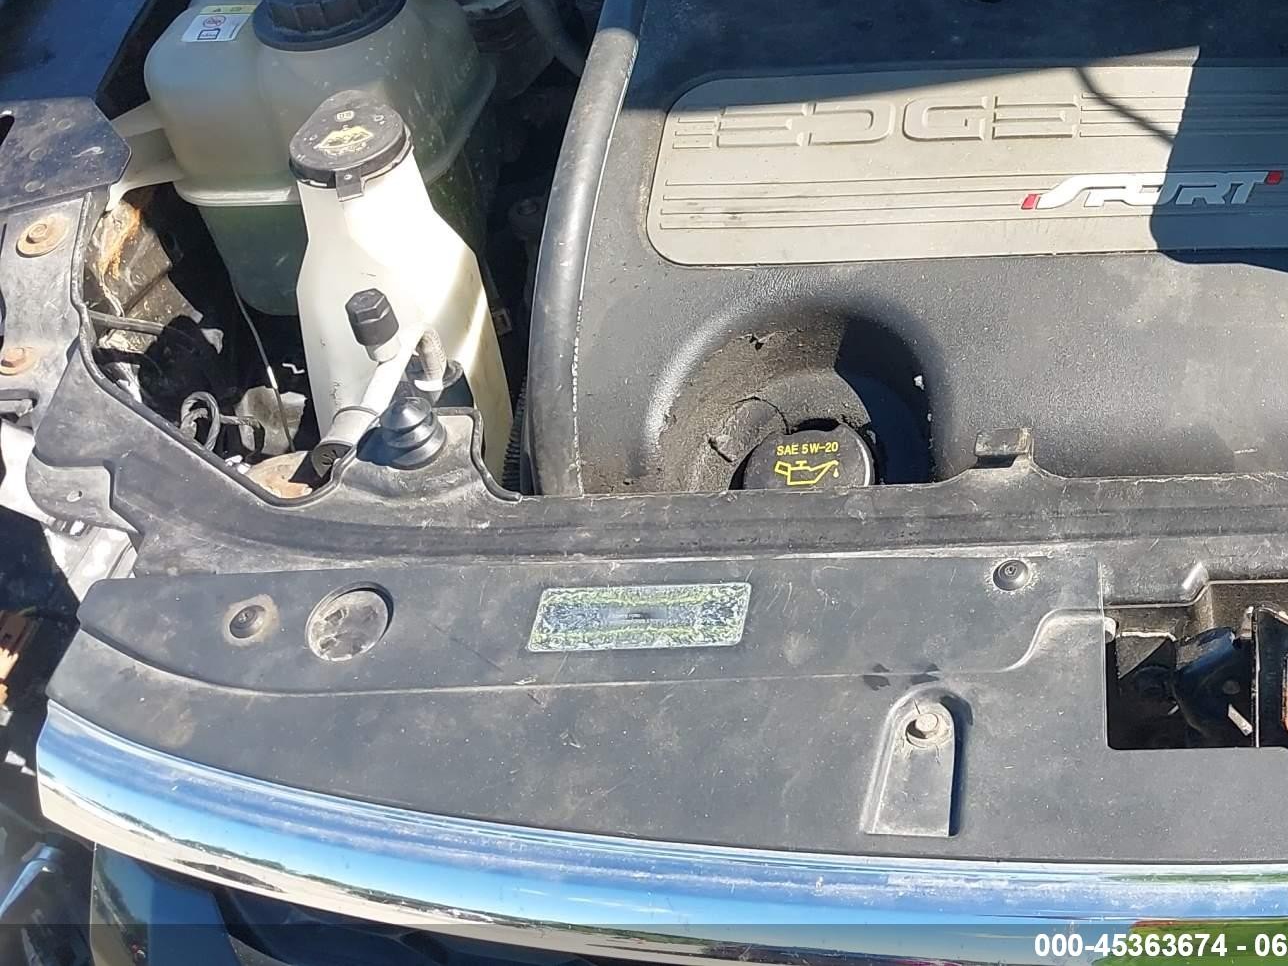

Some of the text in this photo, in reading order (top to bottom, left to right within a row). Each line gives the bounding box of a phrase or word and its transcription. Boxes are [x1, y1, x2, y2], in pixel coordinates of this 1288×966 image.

[715, 94, 1082, 149] EDGE
[1035, 170, 1270, 210] SPORT
[776, 441, 839, 456] SAE 5W-20
